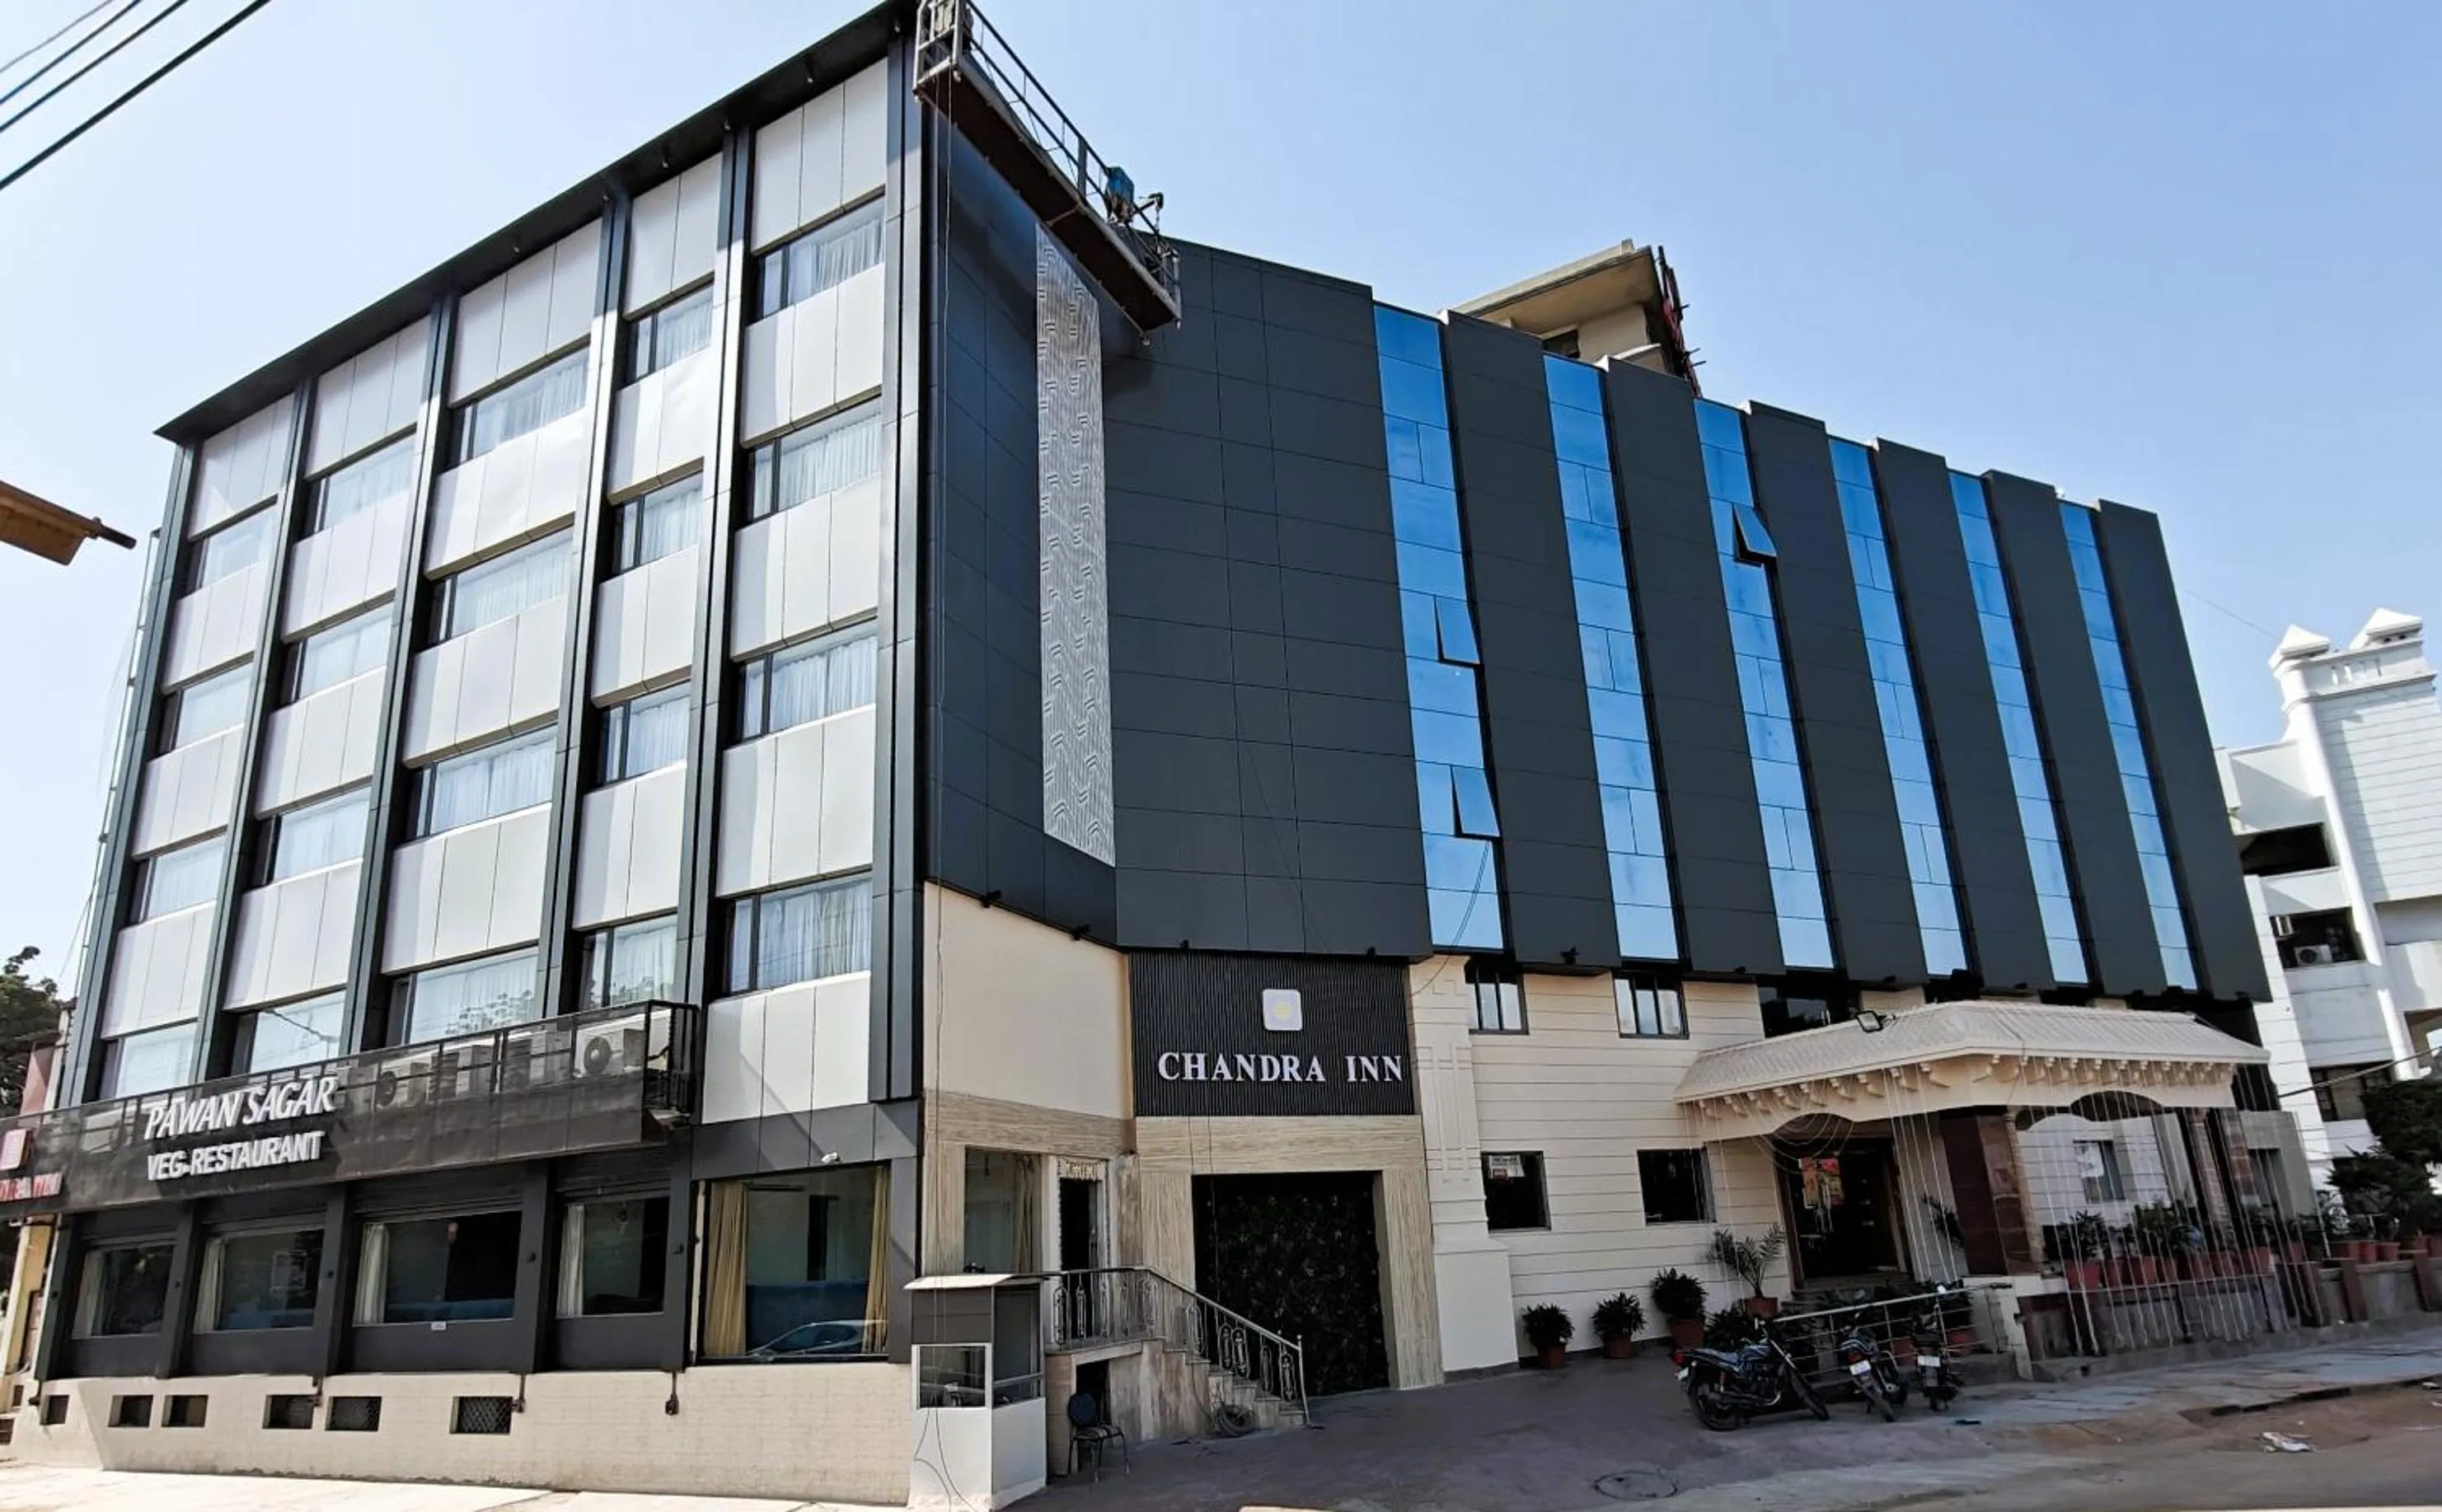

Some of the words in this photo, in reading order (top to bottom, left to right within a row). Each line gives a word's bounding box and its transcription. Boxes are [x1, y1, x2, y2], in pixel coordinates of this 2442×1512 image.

[1158, 1051, 1325, 1083] CHANDRA
[1345, 1055, 1402, 1083] INN
[143, 1091, 244, 1140] PAWAN
[242, 1076, 338, 1126] SAGAR
[148, 1130, 326, 1182] VEG-RESTAURANT
